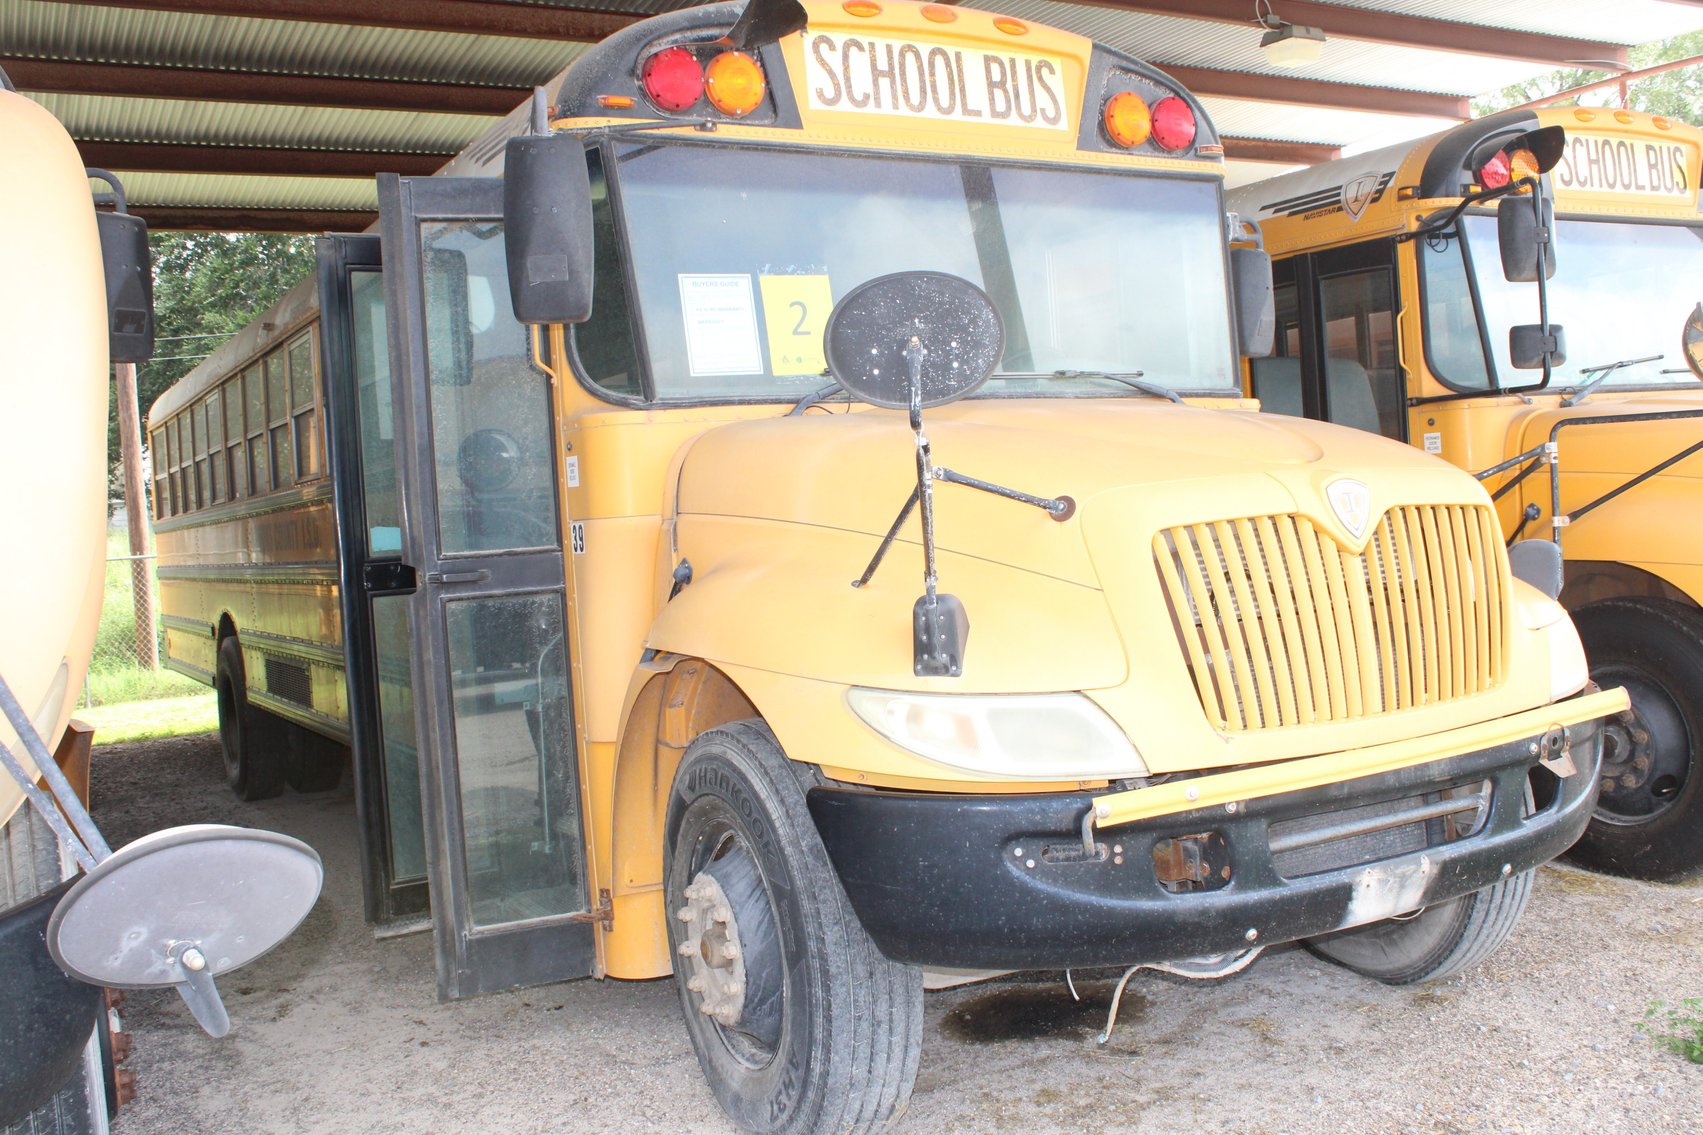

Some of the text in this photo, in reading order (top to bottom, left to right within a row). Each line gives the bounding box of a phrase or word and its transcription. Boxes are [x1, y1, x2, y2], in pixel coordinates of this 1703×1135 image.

[811, 34, 1062, 126] SCHOOL BUS
[1560, 136, 1688, 194] SCHOOL BUS
[1303, 207, 1338, 221] NAVISTAR
[789, 301, 812, 336] 2
[572, 524, 584, 552] 39
